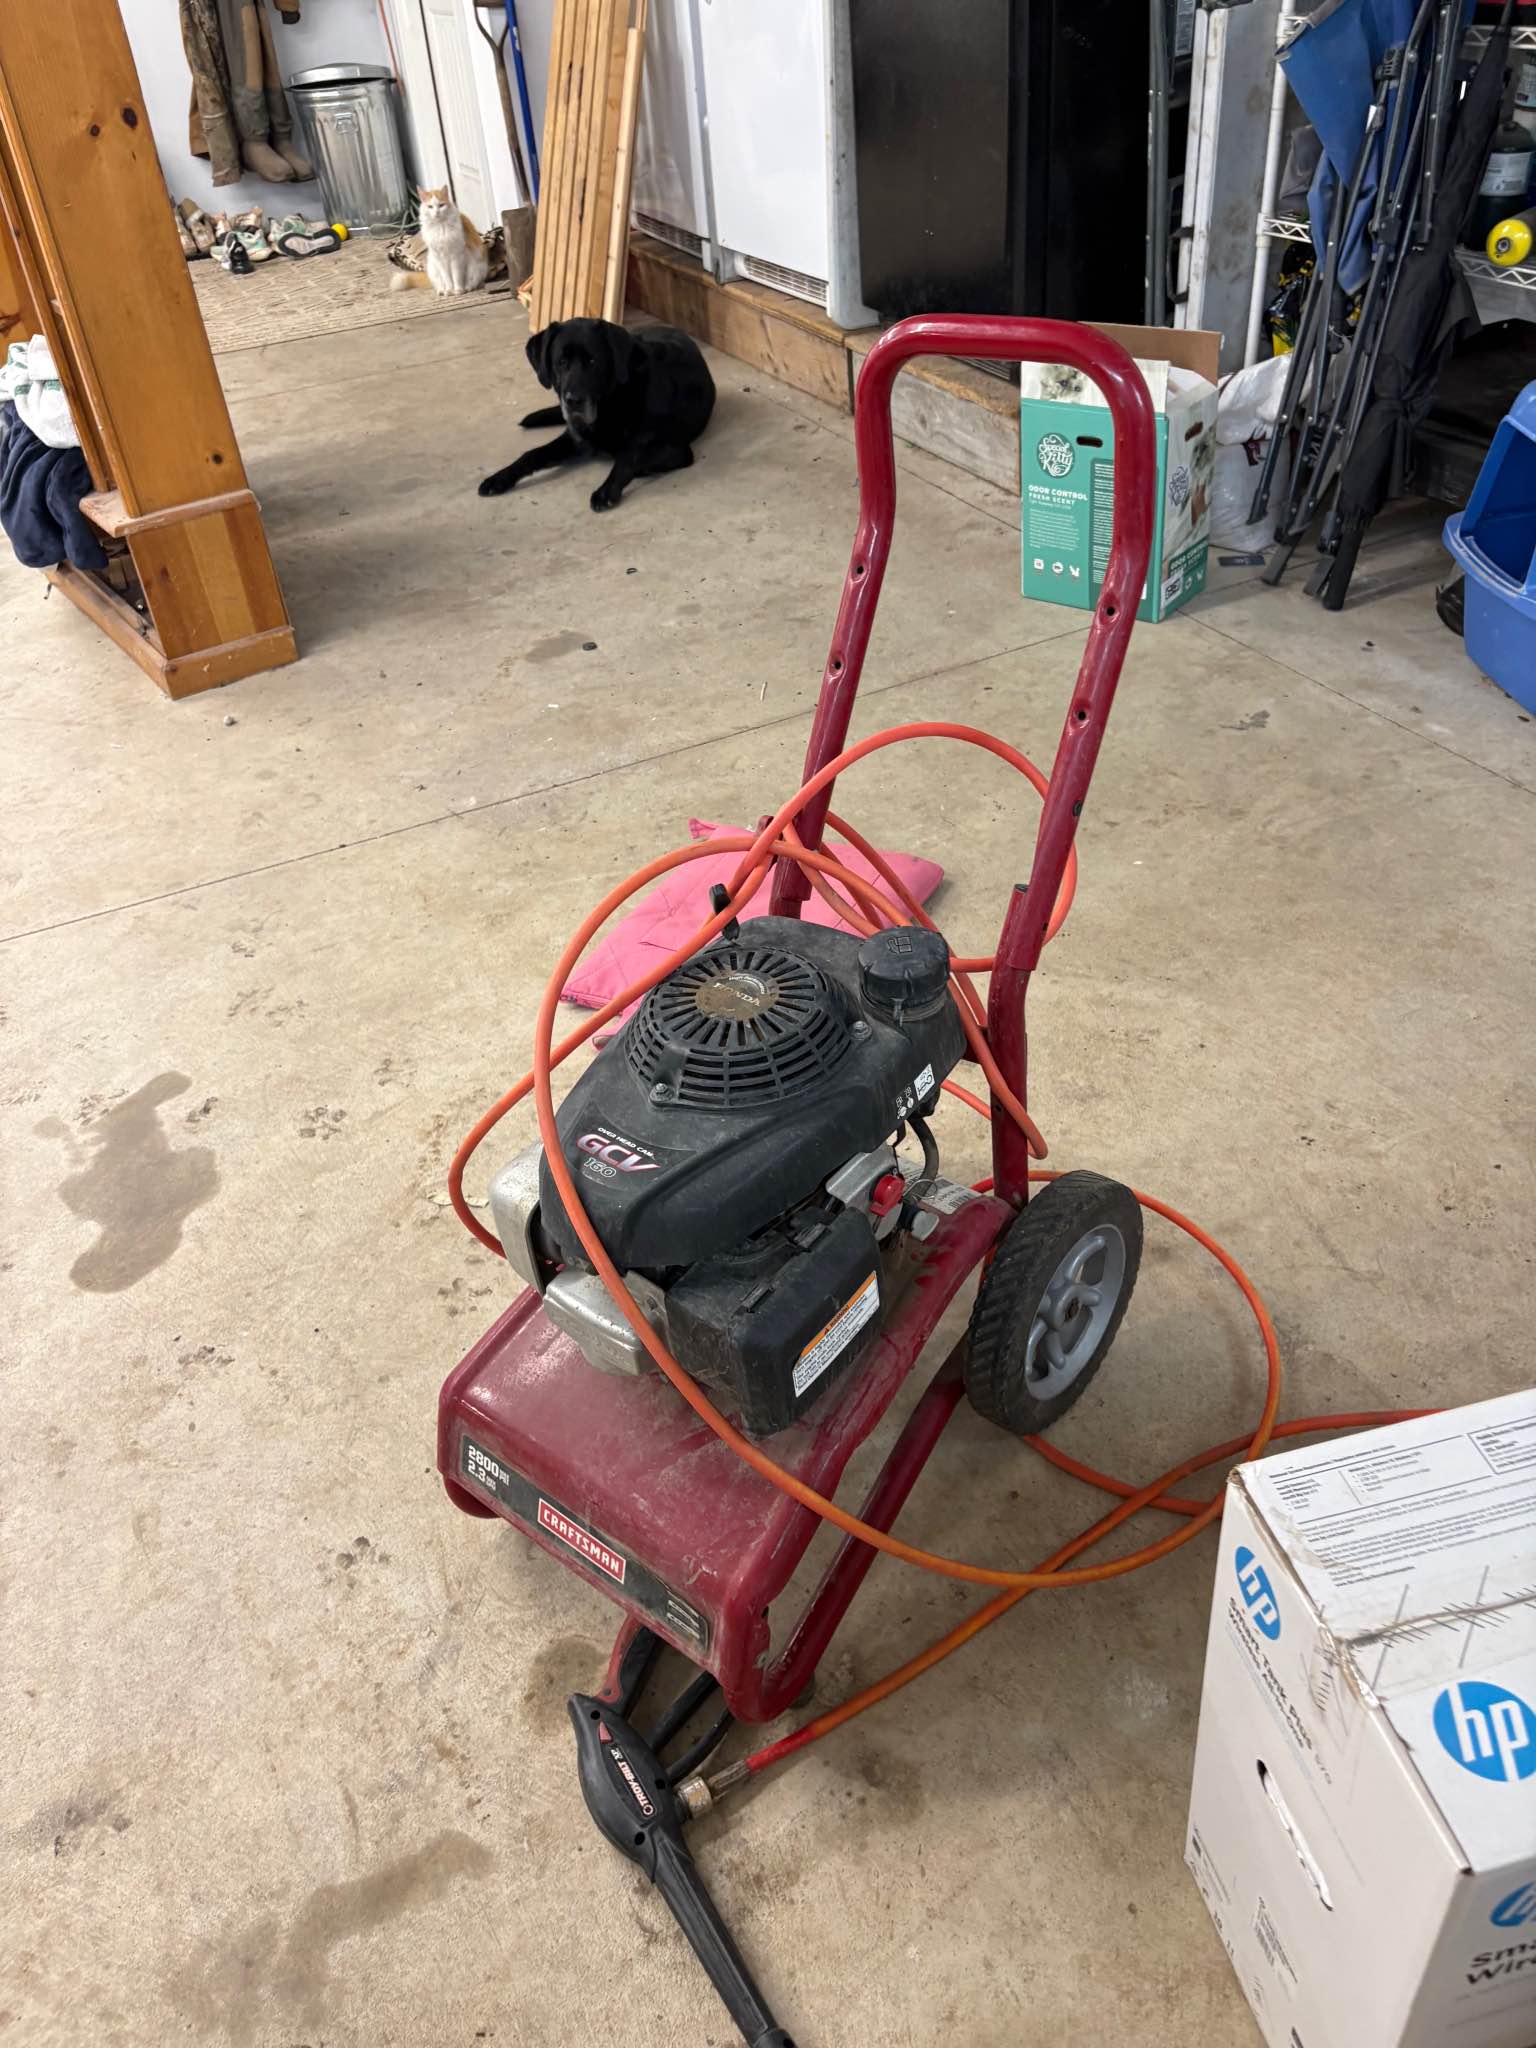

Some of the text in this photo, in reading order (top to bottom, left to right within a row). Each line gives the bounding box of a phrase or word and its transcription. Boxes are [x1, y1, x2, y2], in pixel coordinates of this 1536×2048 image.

[1039, 451, 1073, 477] Kitty
[1028, 484, 1088, 501] ODOR CONTROL
[597, 1127, 617, 1139] OVER
[616, 1136, 637, 1148] HEAD
[577, 1133, 661, 1173] GCV
[584, 1157, 617, 1178] 160
[467, 1459, 487, 1483] 2.3
[468, 1444, 500, 1478] 2800
[543, 1508, 620, 1575] CRAFTSMAN
[1447, 1680, 1530, 1784] hp
[617, 1760, 650, 1808] TROY-BILT
